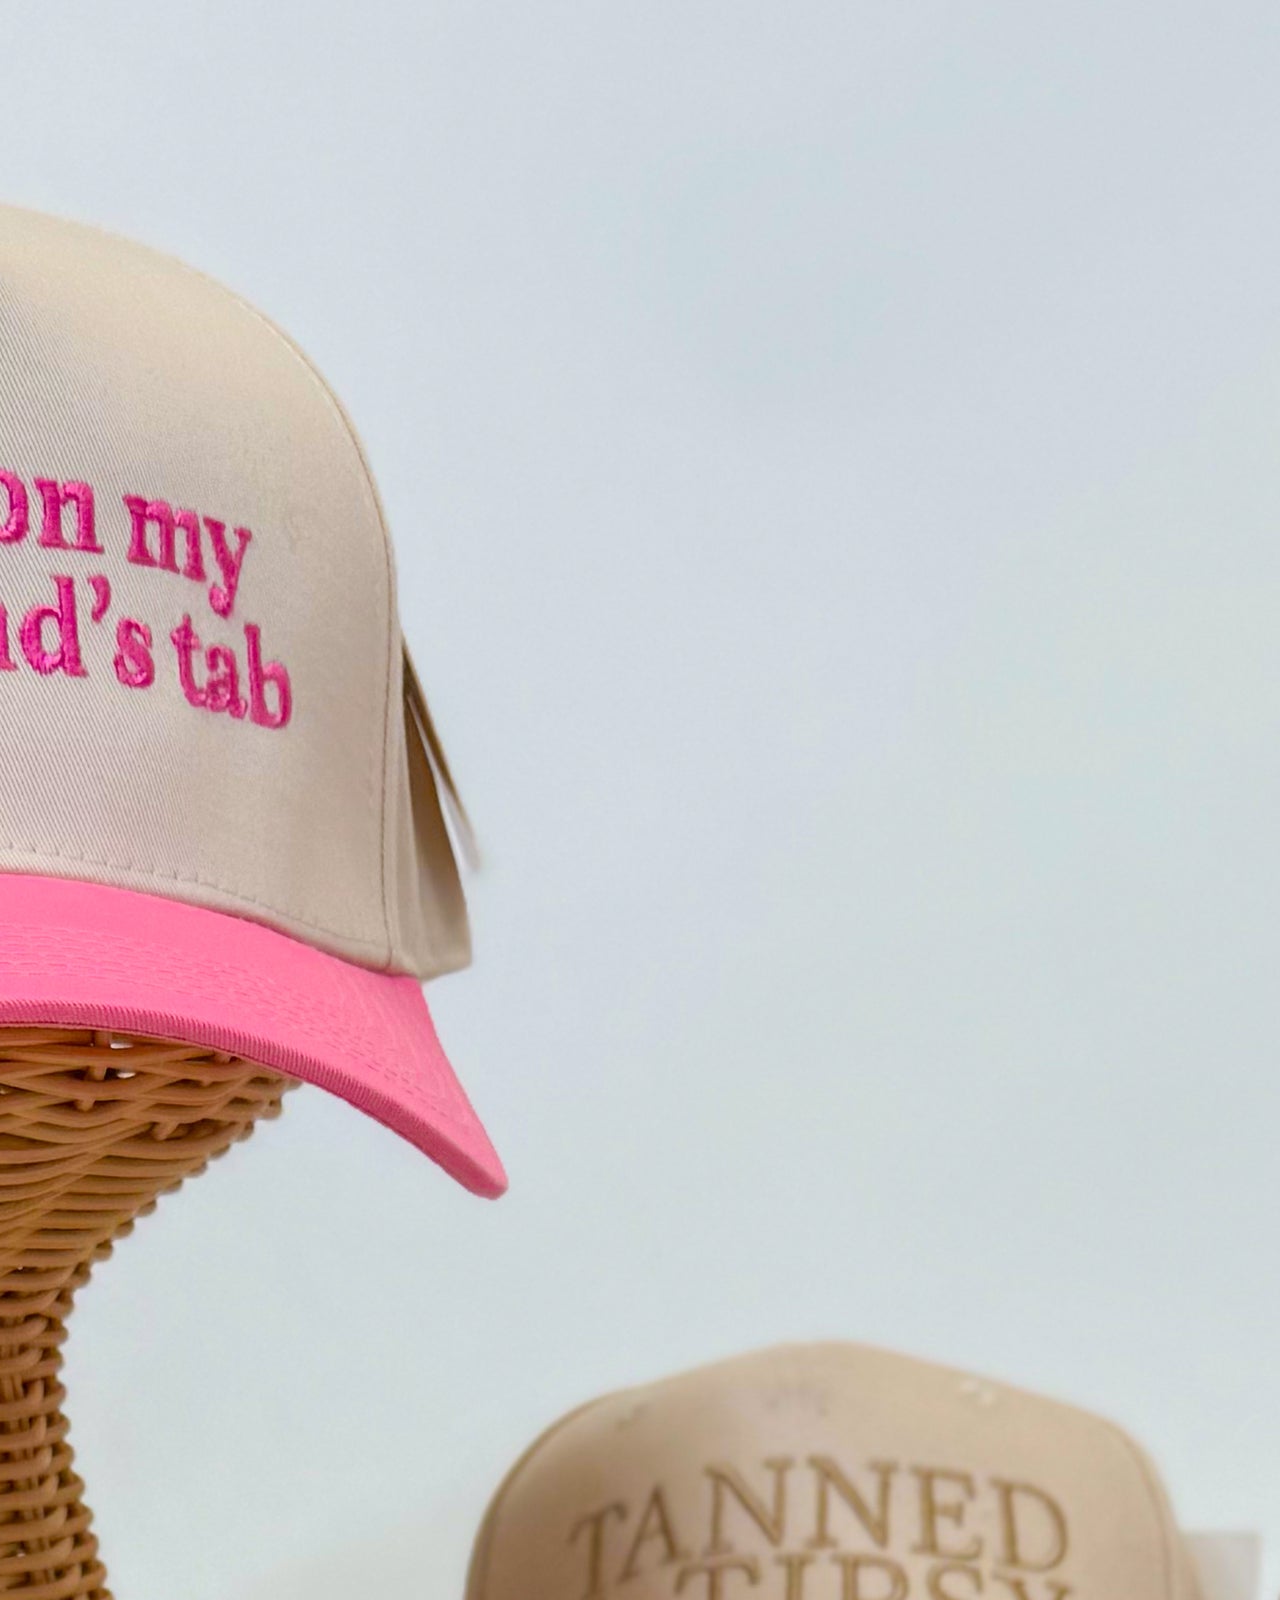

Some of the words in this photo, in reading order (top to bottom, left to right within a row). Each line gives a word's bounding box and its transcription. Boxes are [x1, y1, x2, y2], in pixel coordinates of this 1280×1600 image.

[123, 494, 252, 618] my
[171, 614, 293, 729] tab
[567, 1454, 1070, 1600] TANNED
